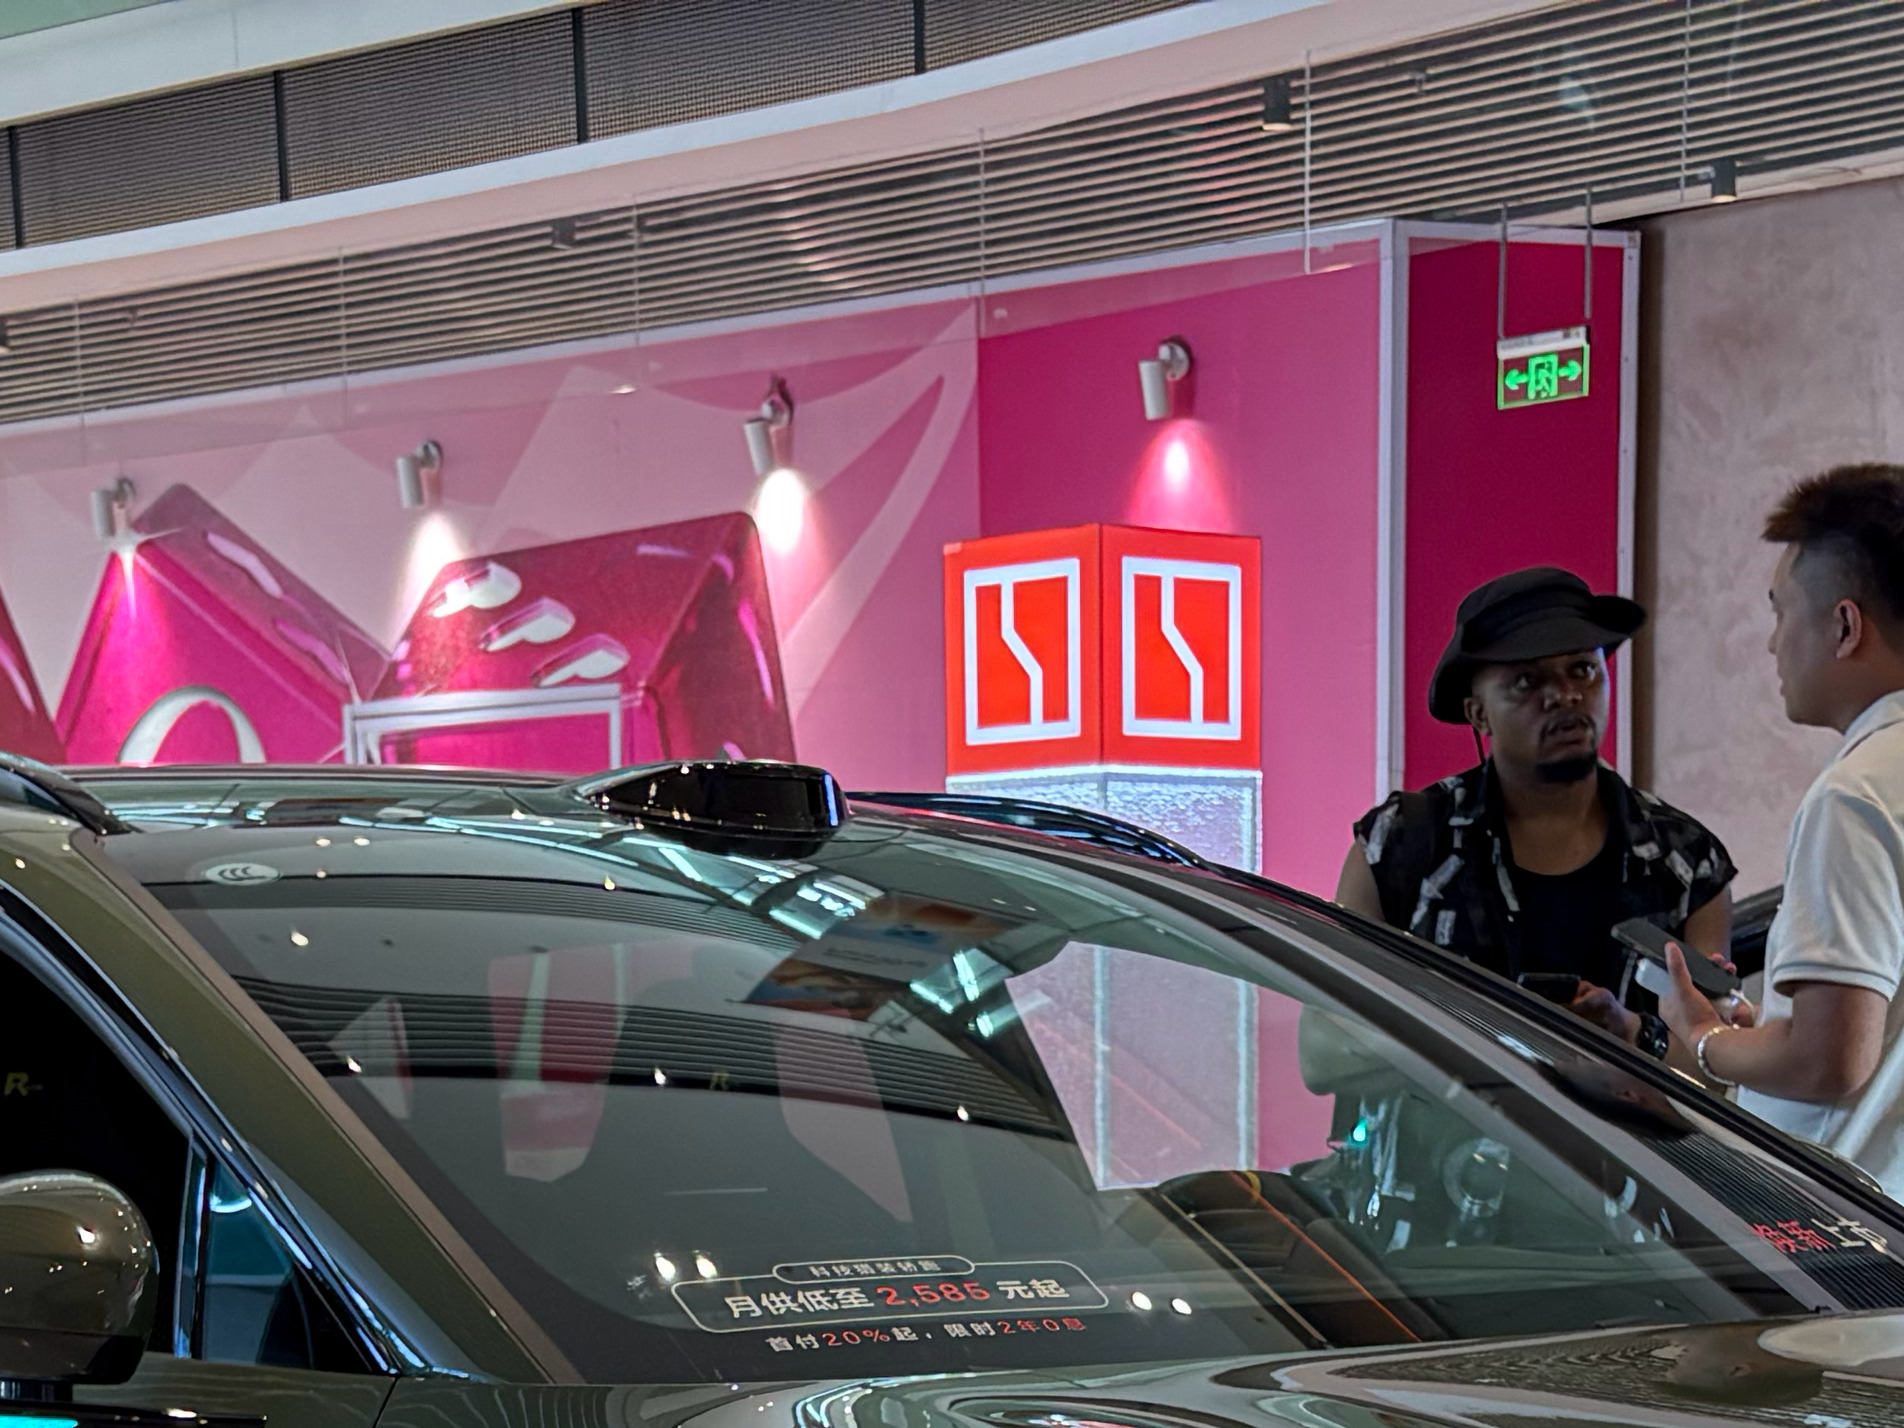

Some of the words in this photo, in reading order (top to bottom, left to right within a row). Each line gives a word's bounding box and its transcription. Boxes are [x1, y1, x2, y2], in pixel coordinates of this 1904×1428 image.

[724, 1286, 875, 1320] 月供低至
[876, 1280, 991, 1308] 2,585
[997, 1278, 1070, 1299] 元起
